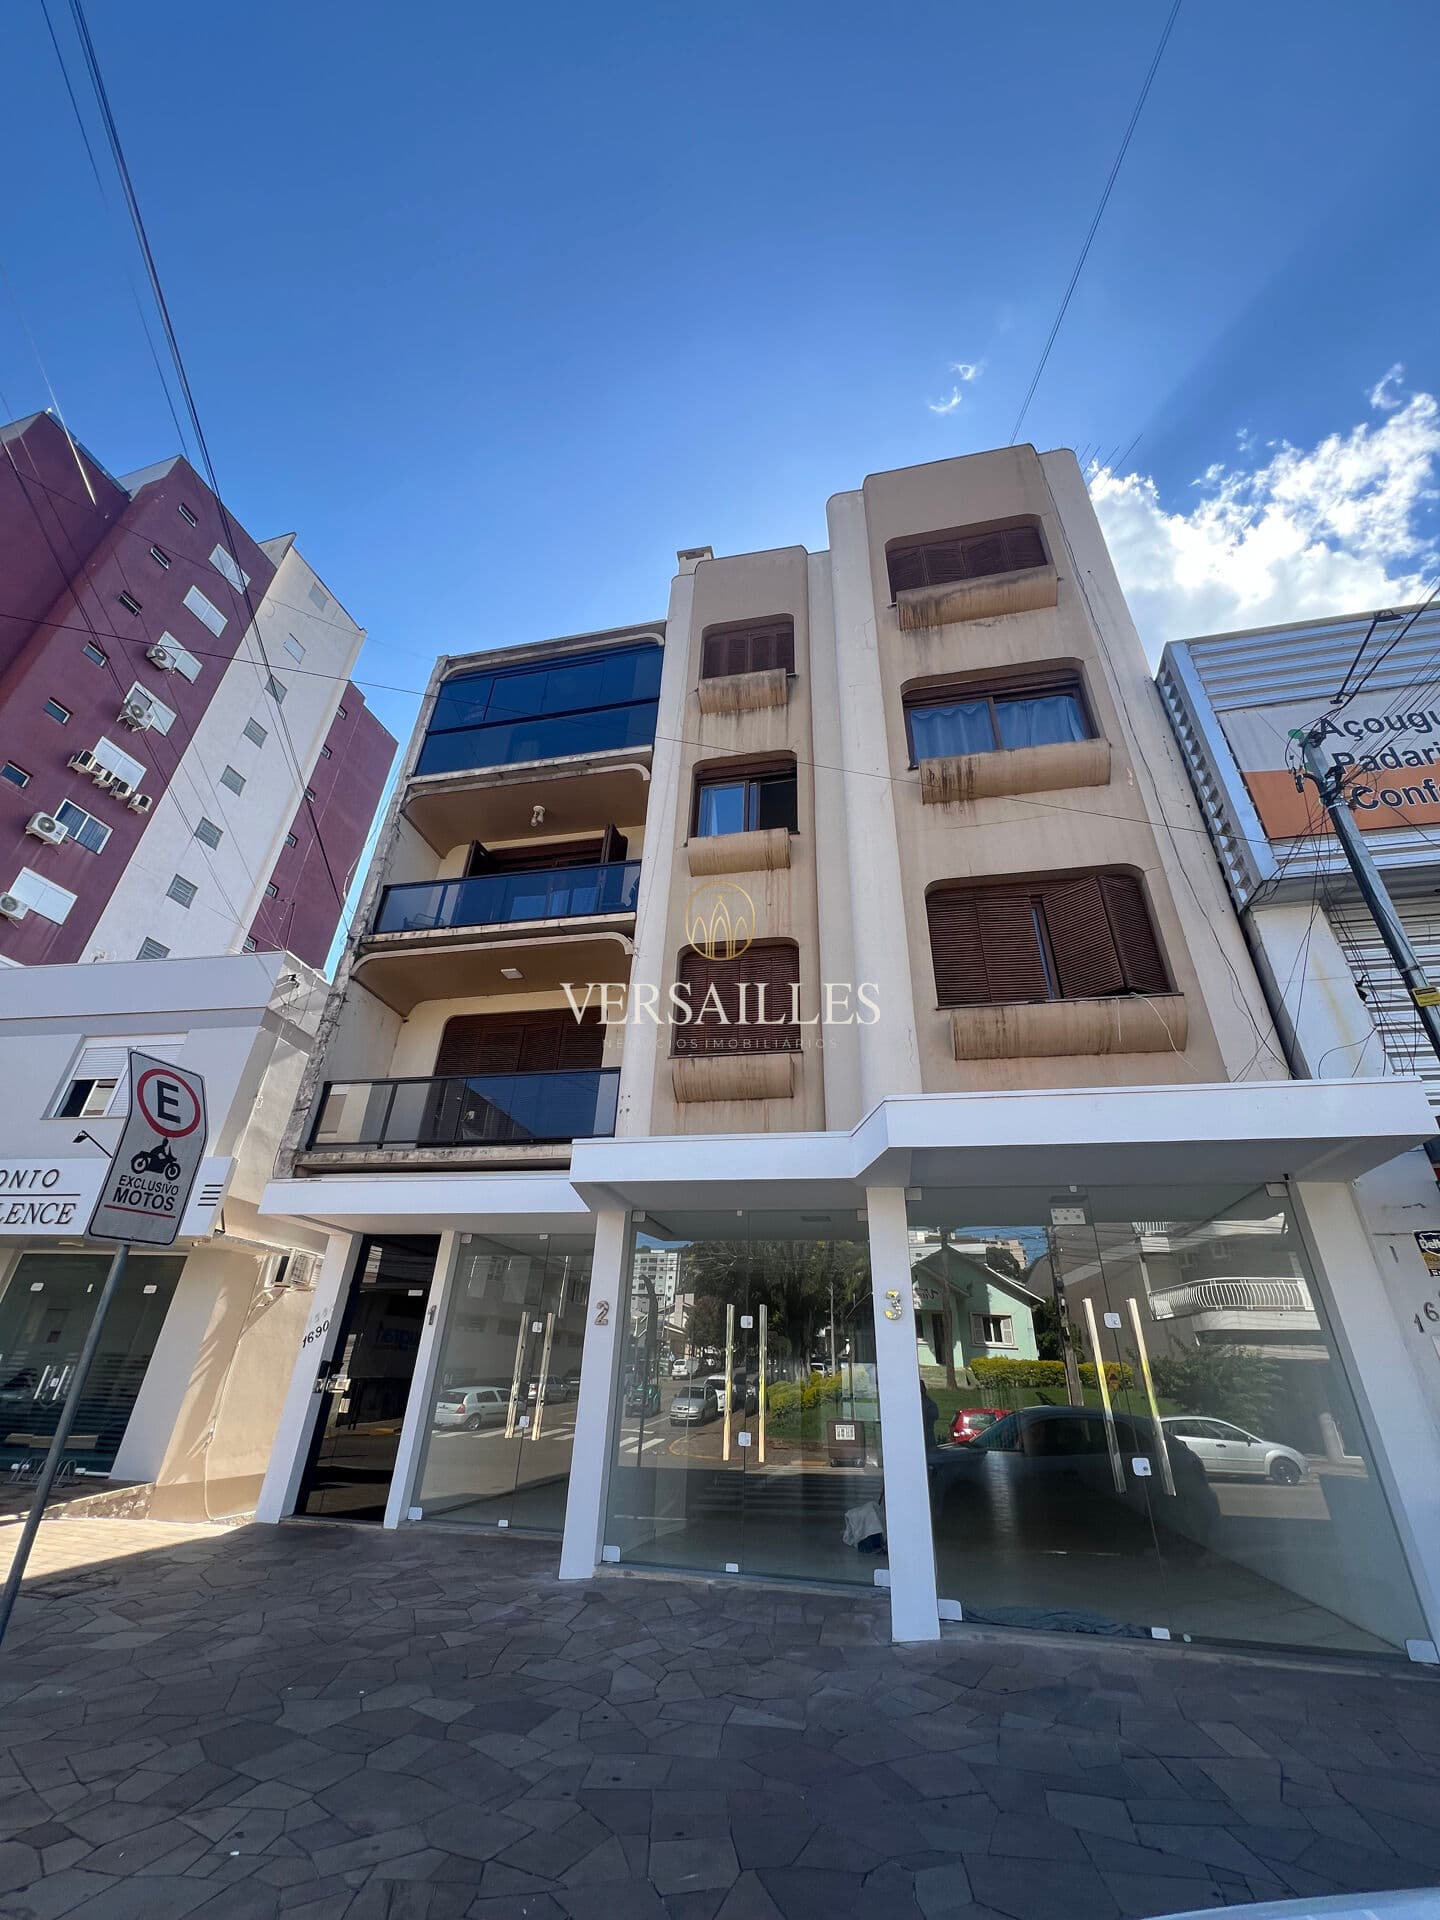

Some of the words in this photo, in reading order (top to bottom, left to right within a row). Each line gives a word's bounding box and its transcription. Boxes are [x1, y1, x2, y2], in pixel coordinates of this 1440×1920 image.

[1352, 779, 1440, 810] Conf
[156, 1080, 181, 1124] E
[112, 1187, 175, 1211] MOTOS
[118, 1174, 179, 1196] EXCLUSIVO
[0, 1202, 77, 1225] ENCE
[594, 1300, 610, 1326] 2
[884, 1289, 902, 1321] 3
[1413, 1290, 1440, 1333] 16
[302, 1319, 330, 1349] 1690
